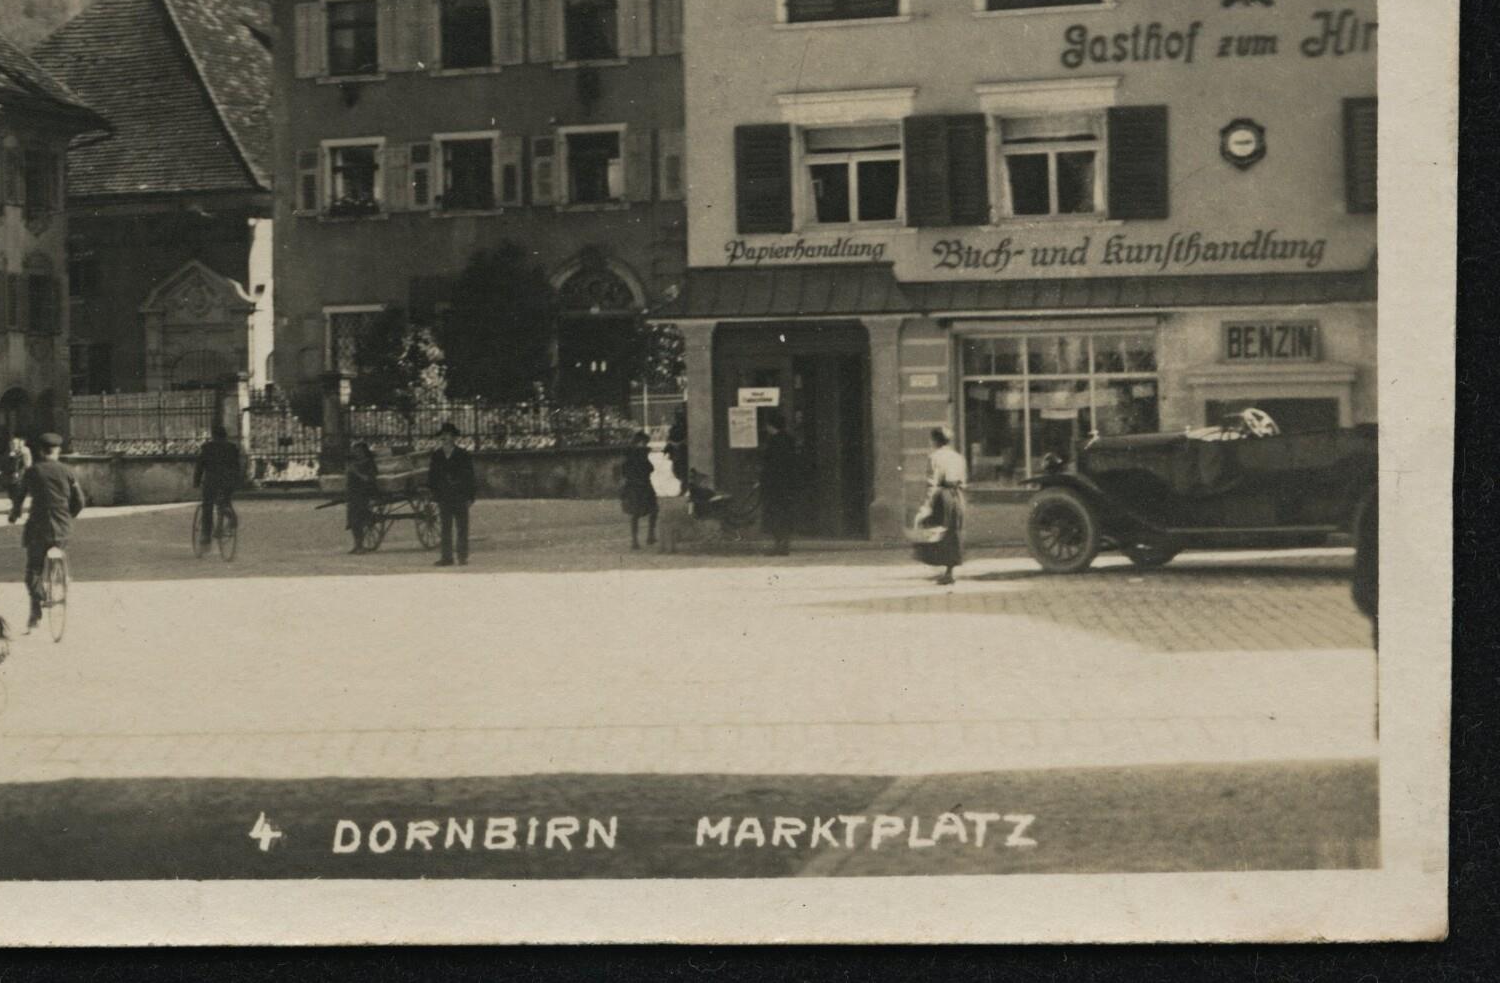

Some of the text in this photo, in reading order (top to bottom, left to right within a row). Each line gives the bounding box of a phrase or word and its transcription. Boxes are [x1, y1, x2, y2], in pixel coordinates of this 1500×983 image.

[1060, 21, 1203, 68] Gasthof
[1215, 34, 1279, 59] zum
[724, 237, 887, 265] Papierhandlung
[1030, 236, 1089, 266] und
[1227, 324, 1314, 359] BENZIN
